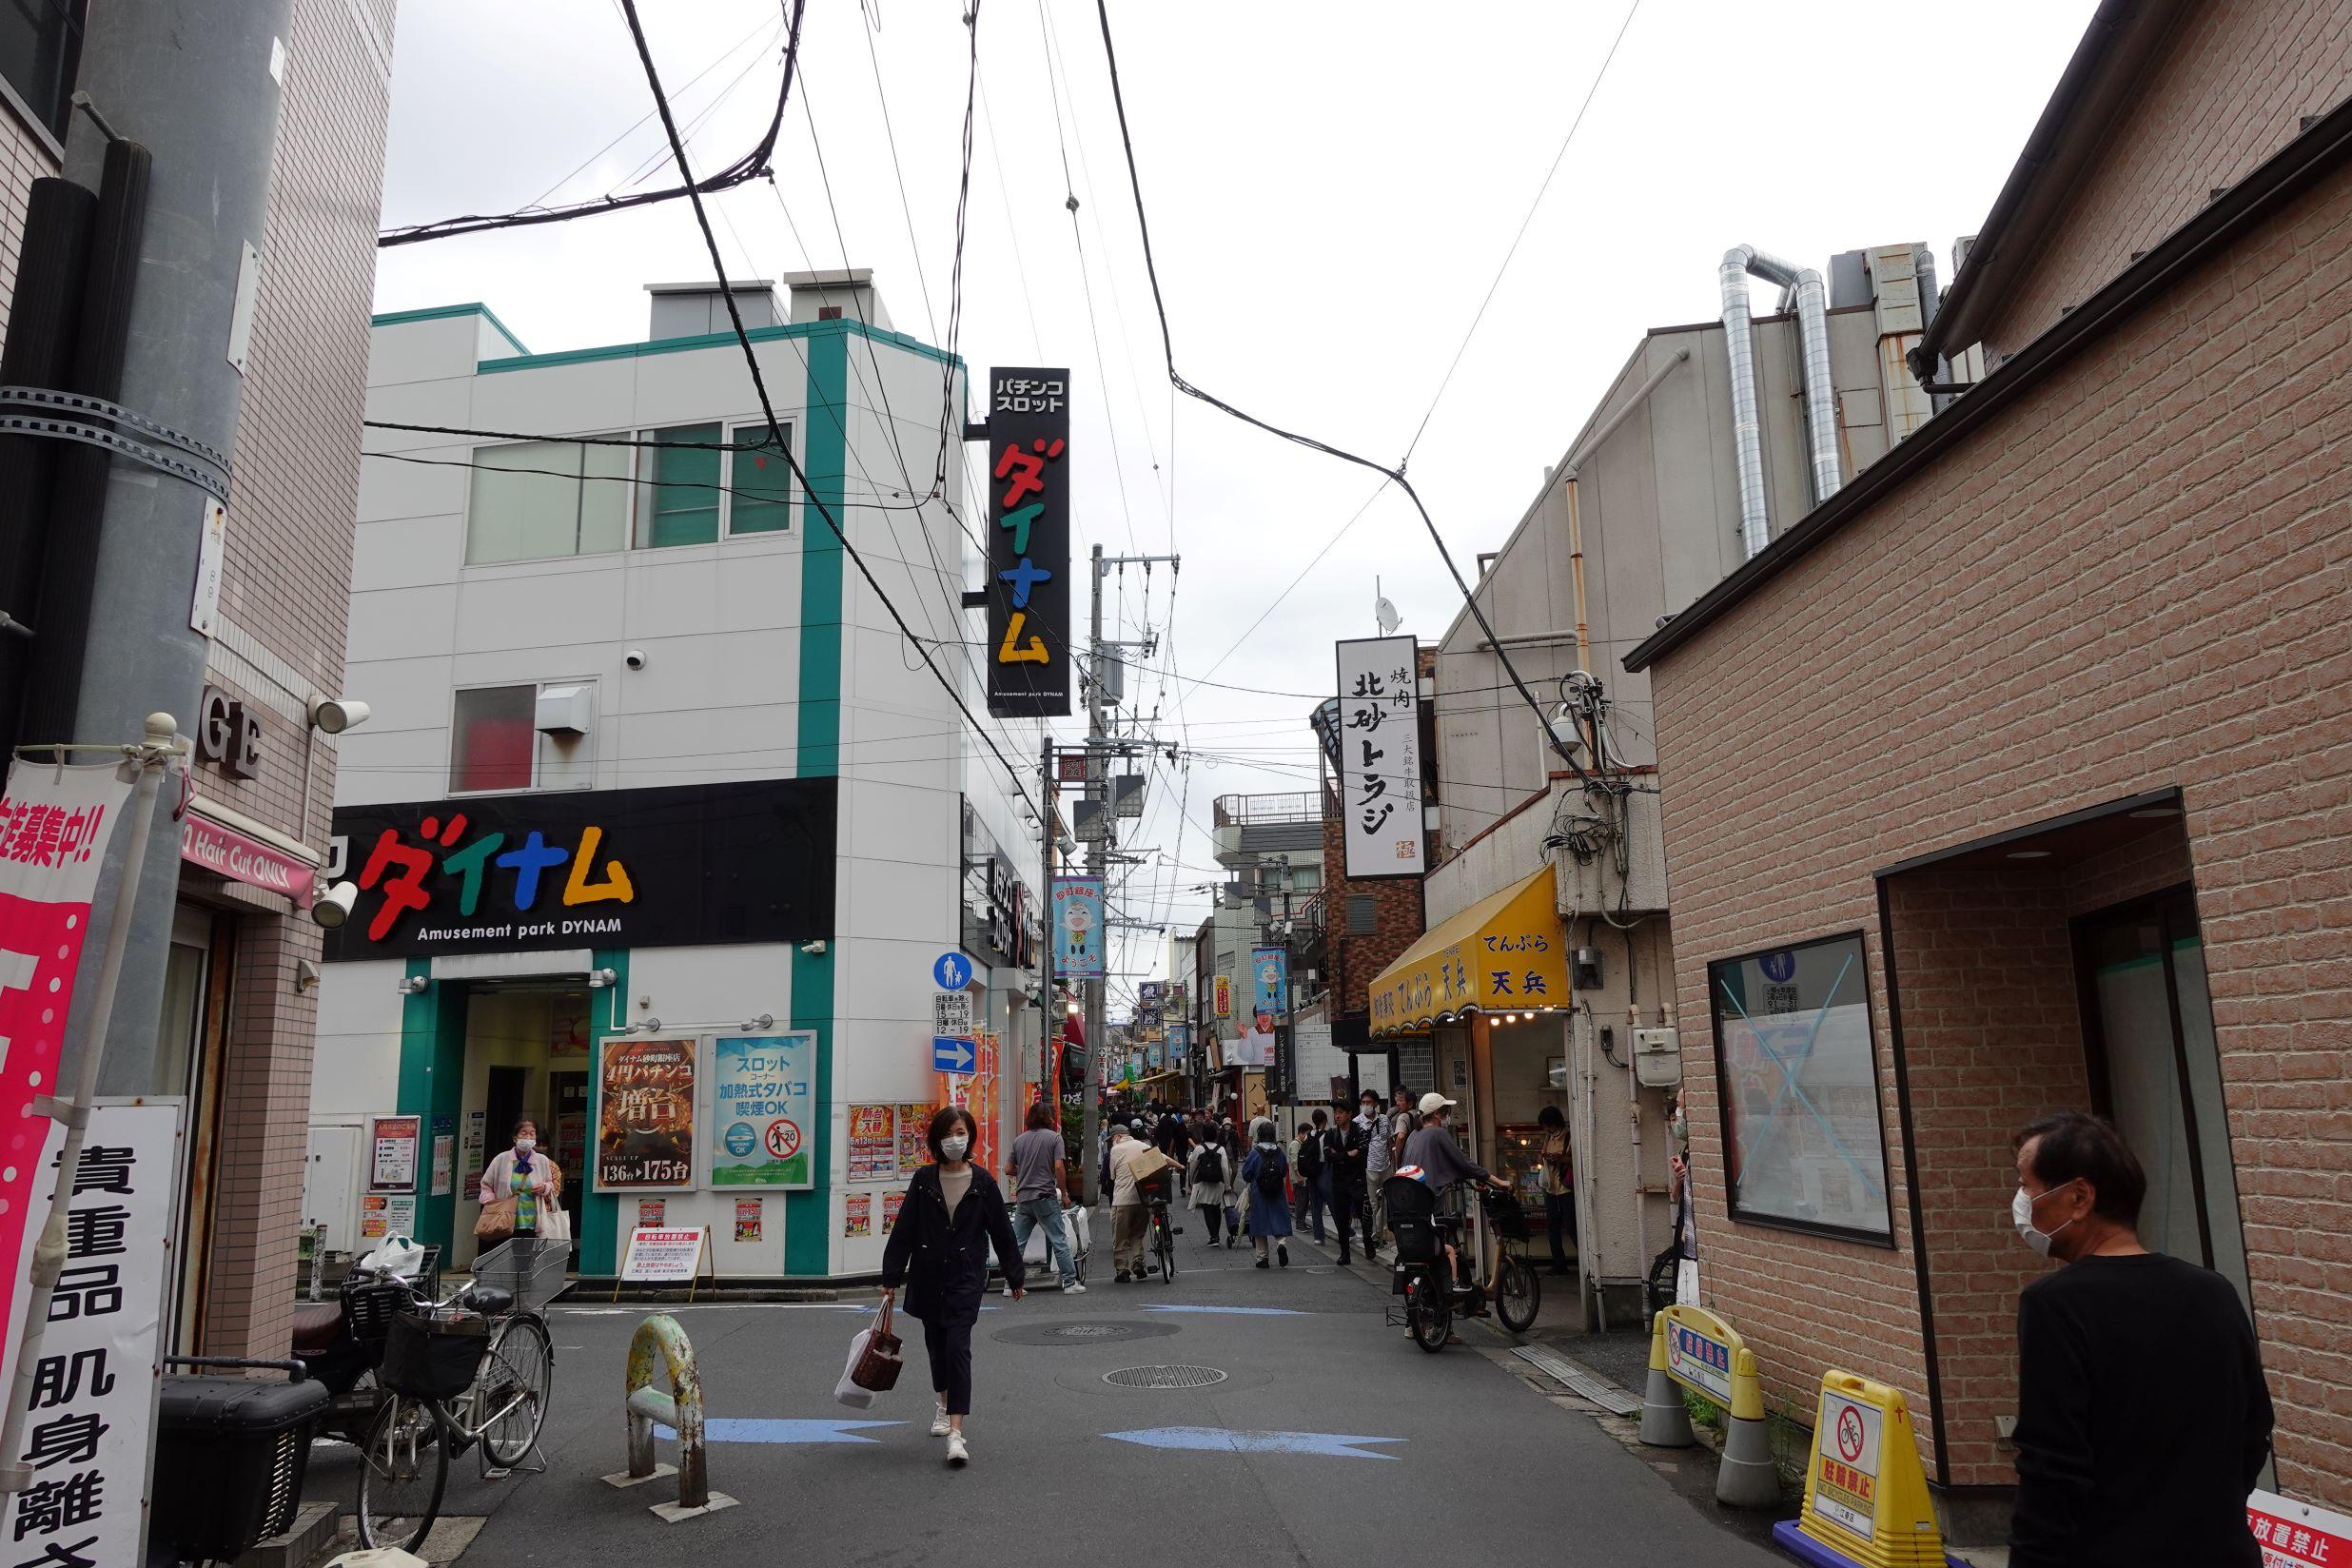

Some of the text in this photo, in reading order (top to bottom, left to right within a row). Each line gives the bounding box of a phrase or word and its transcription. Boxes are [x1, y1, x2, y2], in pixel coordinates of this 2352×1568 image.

[997, 379, 1064, 396] パチンコ
[997, 397, 1064, 413] スロット
[994, 438, 1066, 664] ダイナム
[1390, 667, 1412, 709] 焼肉
[1346, 671, 1394, 835] 北砂トラジ
[195, 830, 227, 866] Hair
[230, 845, 253, 875] Cut
[254, 855, 291, 889] ONLY
[359, 813, 635, 941] ダイナム
[418, 918, 622, 941] Amusement park DYNAM
[1483, 934, 1549, 951] てんぷら
[1061, 953, 1097, 968] ようこそ
[1397, 970, 1432, 1014] てんぷら
[1441, 958, 1466, 1001] 天兵
[1491, 970, 1547, 995] 天兵
[936, 994, 970, 1003] 自転車を除く
[936, 1010, 947, 1019] 15
[606, 1064, 693, 1083] 4円パチンコ
[736, 1055, 791, 1072] スロット
[719, 1081, 807, 1099] 加熱式タバコ
[617, 1086, 676, 1122] 増台
[735, 1100, 788, 1117] 喫煙OK
[784, 1132, 795, 1142] 20
[603, 1160, 689, 1182] 136台 175台
[47, 1145, 136, 1323] 貴重品
[1685, 1332, 1725, 1368] 駐輪禁止
[1823, 1459, 1871, 1499] 駐輪禁止
